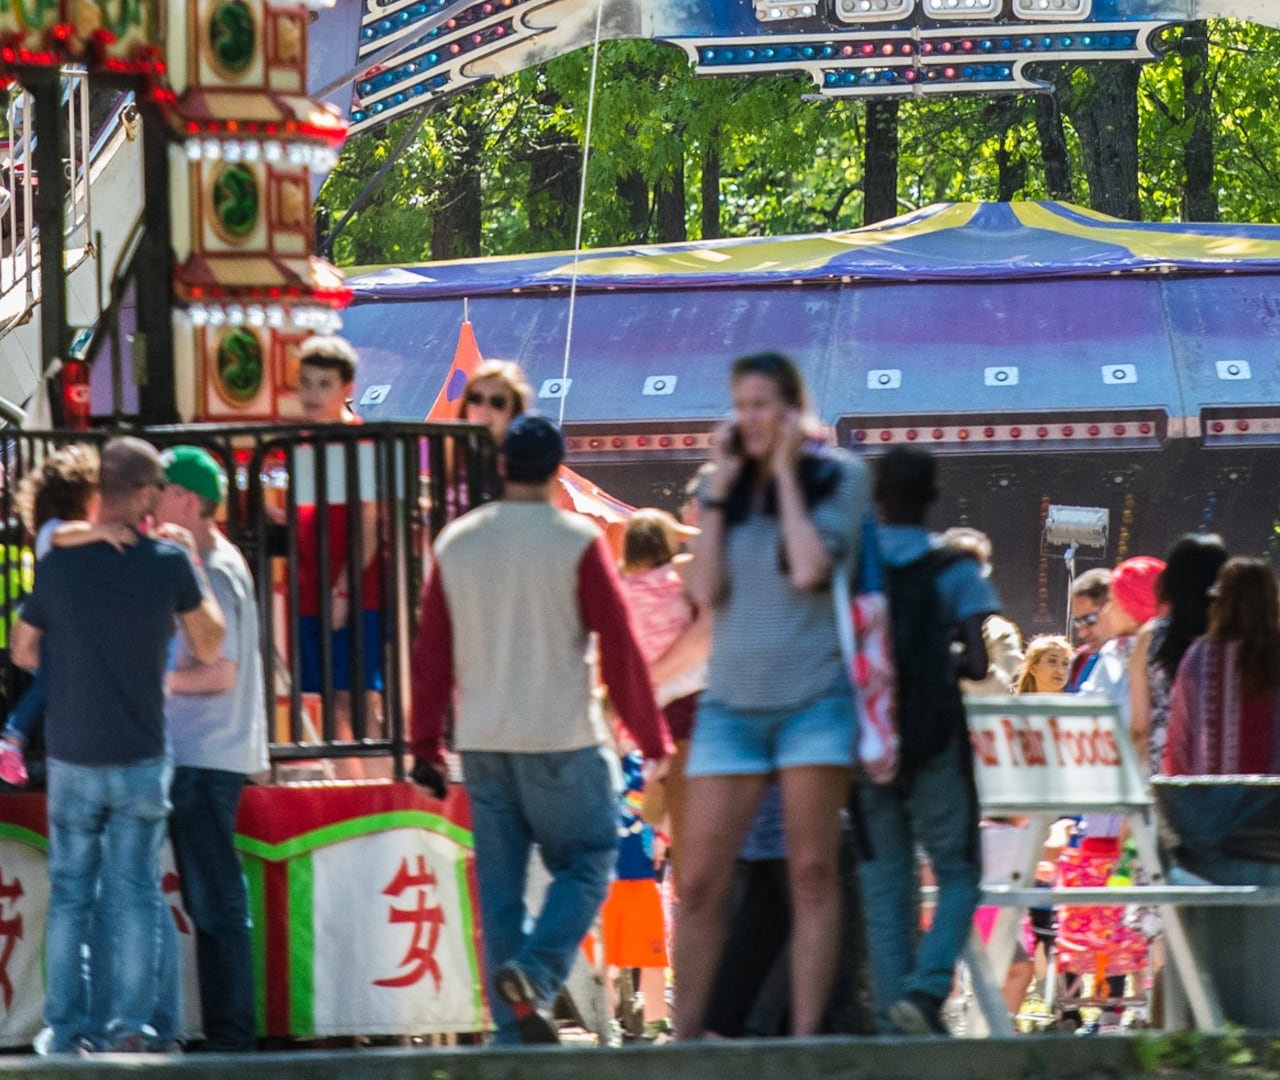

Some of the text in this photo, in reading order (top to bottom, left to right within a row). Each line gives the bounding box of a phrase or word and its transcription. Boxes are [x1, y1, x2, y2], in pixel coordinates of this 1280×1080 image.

[968, 716, 1122, 766] ur Fair Foods
